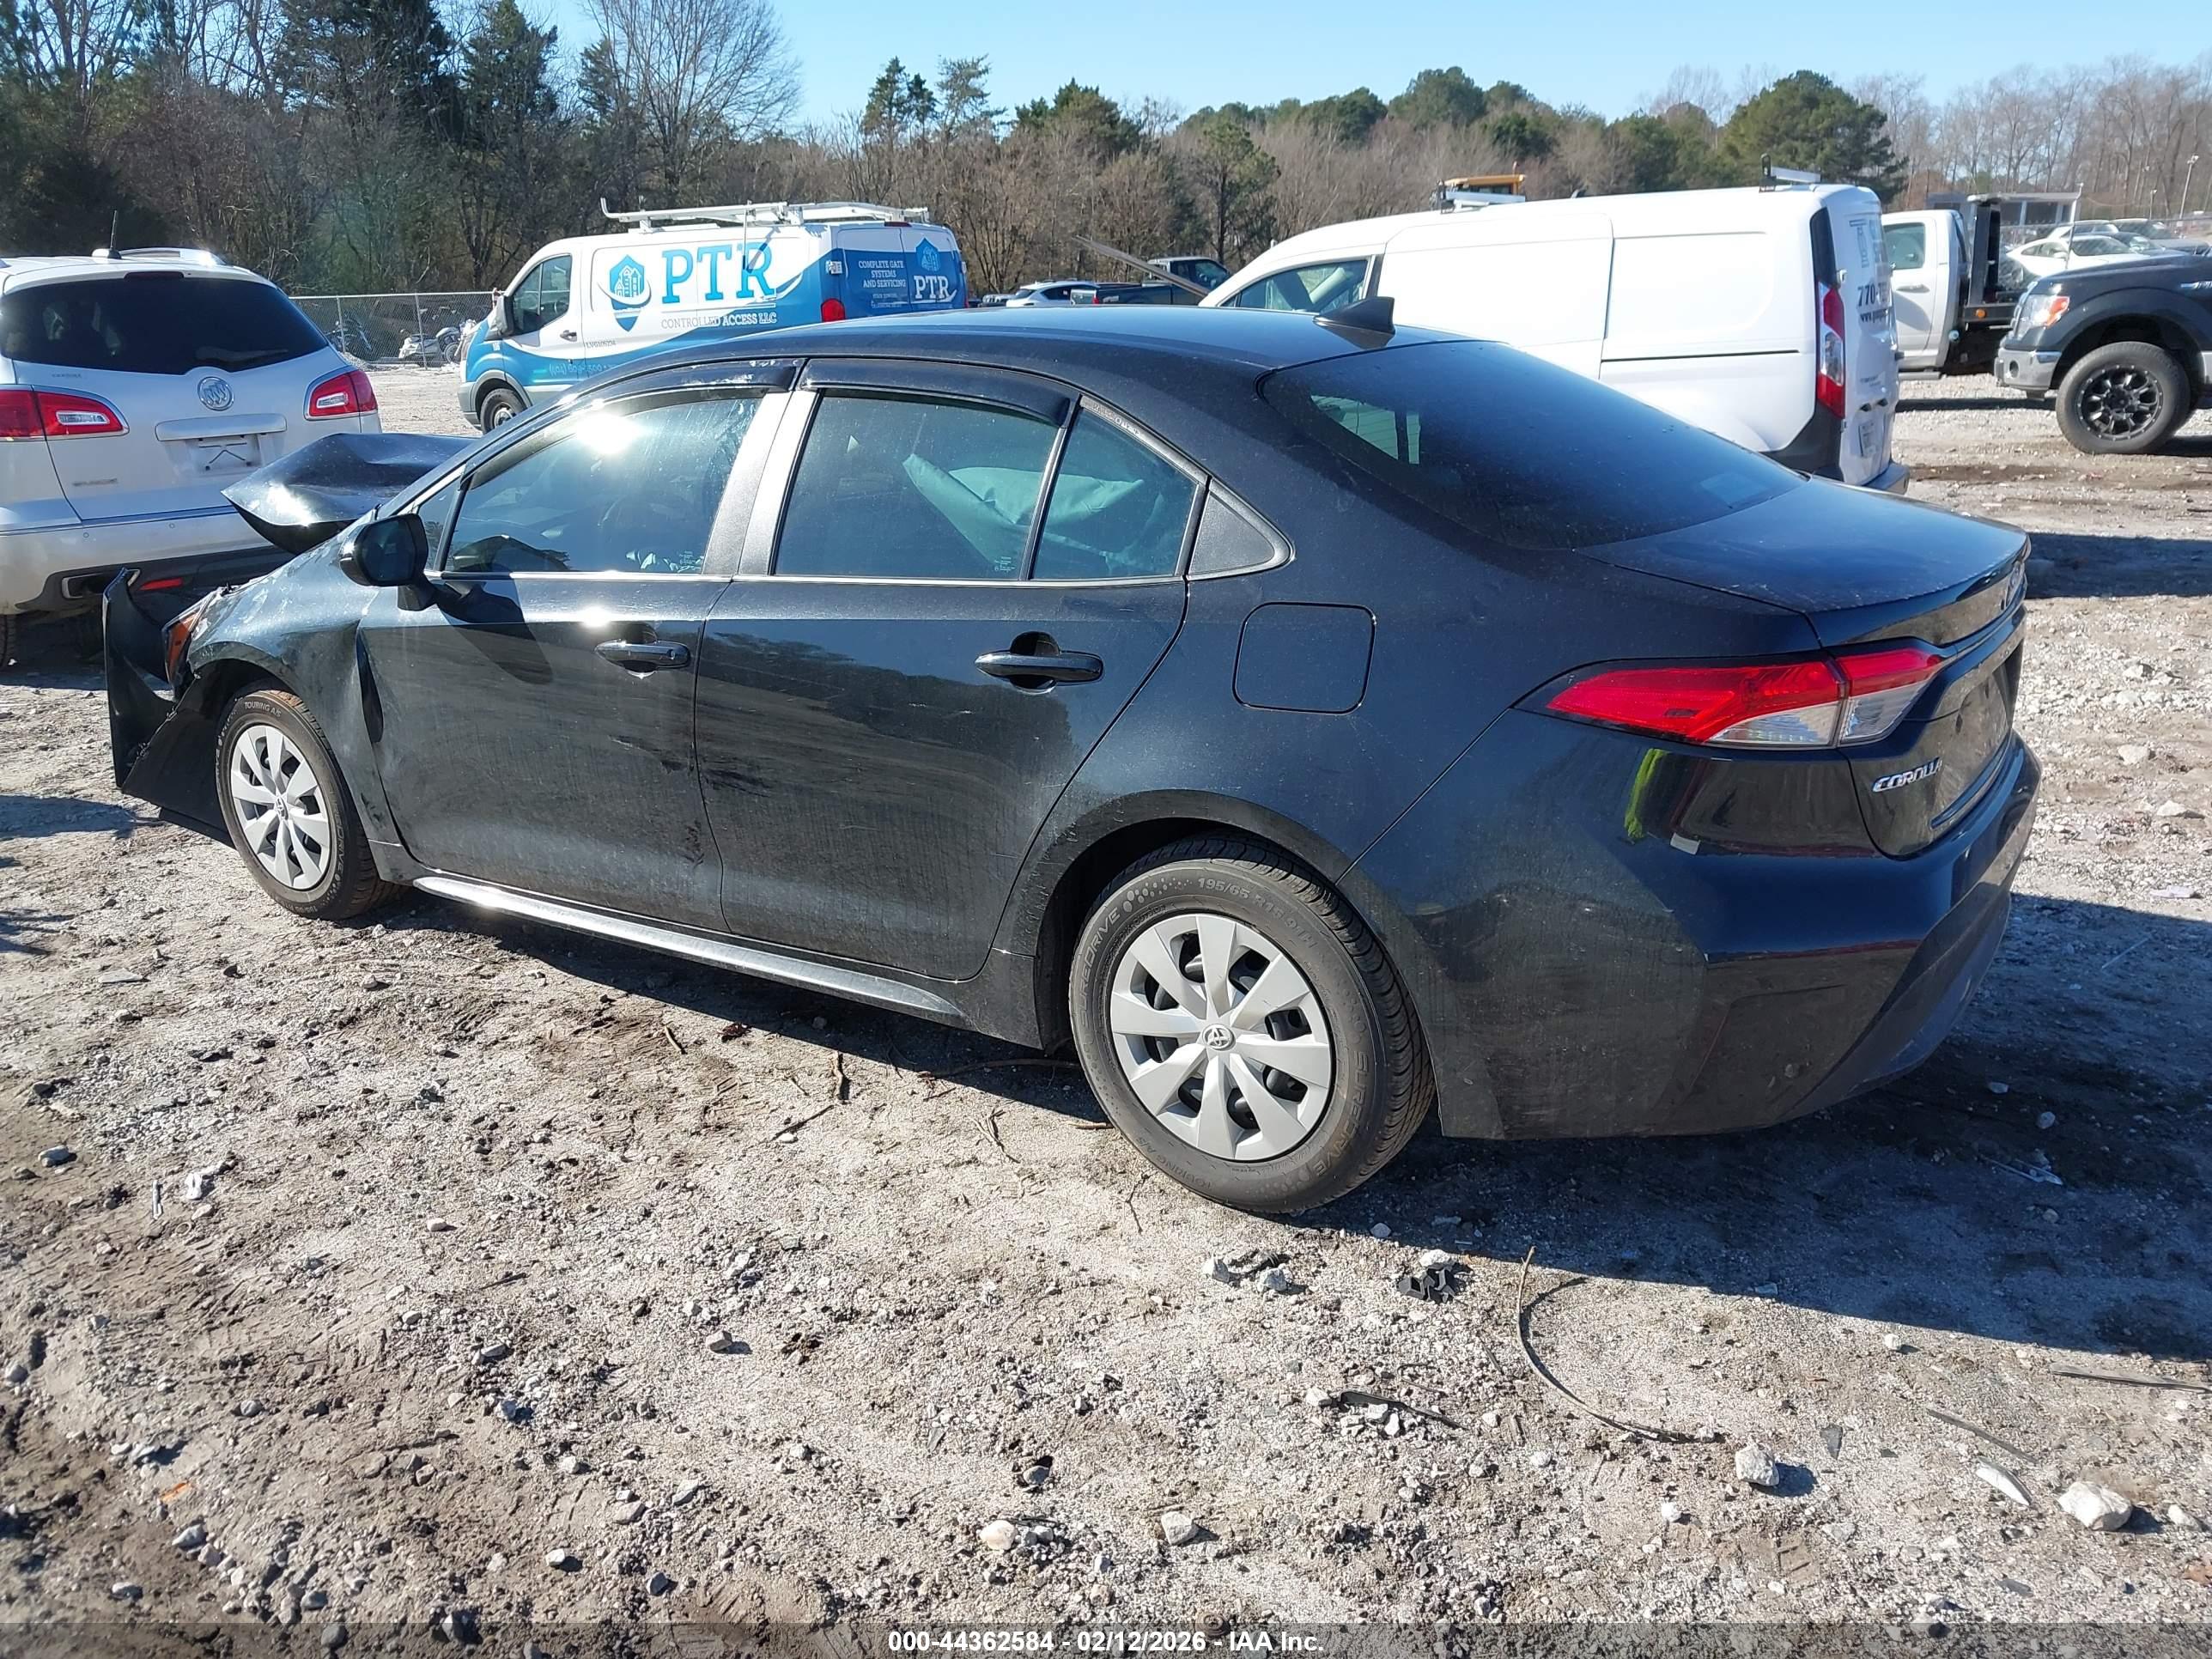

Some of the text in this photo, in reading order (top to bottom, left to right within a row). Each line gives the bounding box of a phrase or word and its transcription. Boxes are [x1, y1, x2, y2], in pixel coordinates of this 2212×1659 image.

[662, 242, 776, 304] PTR
[859, 260, 888, 269] COMPLETE
[863, 279, 907, 288] AND SERVICING
[914, 275, 950, 300] PTR
[661, 312, 777, 329] CONTROLLED ACCESS LLC
[244, 702, 283, 717] TOURING A/S
[1873, 758, 1943, 793] COROLLA
[1198, 878, 1251, 899] 195/65
[1079, 907, 1121, 1029] SUREDRIVE
[1313, 1050, 1369, 1176] SUREDRIVE
